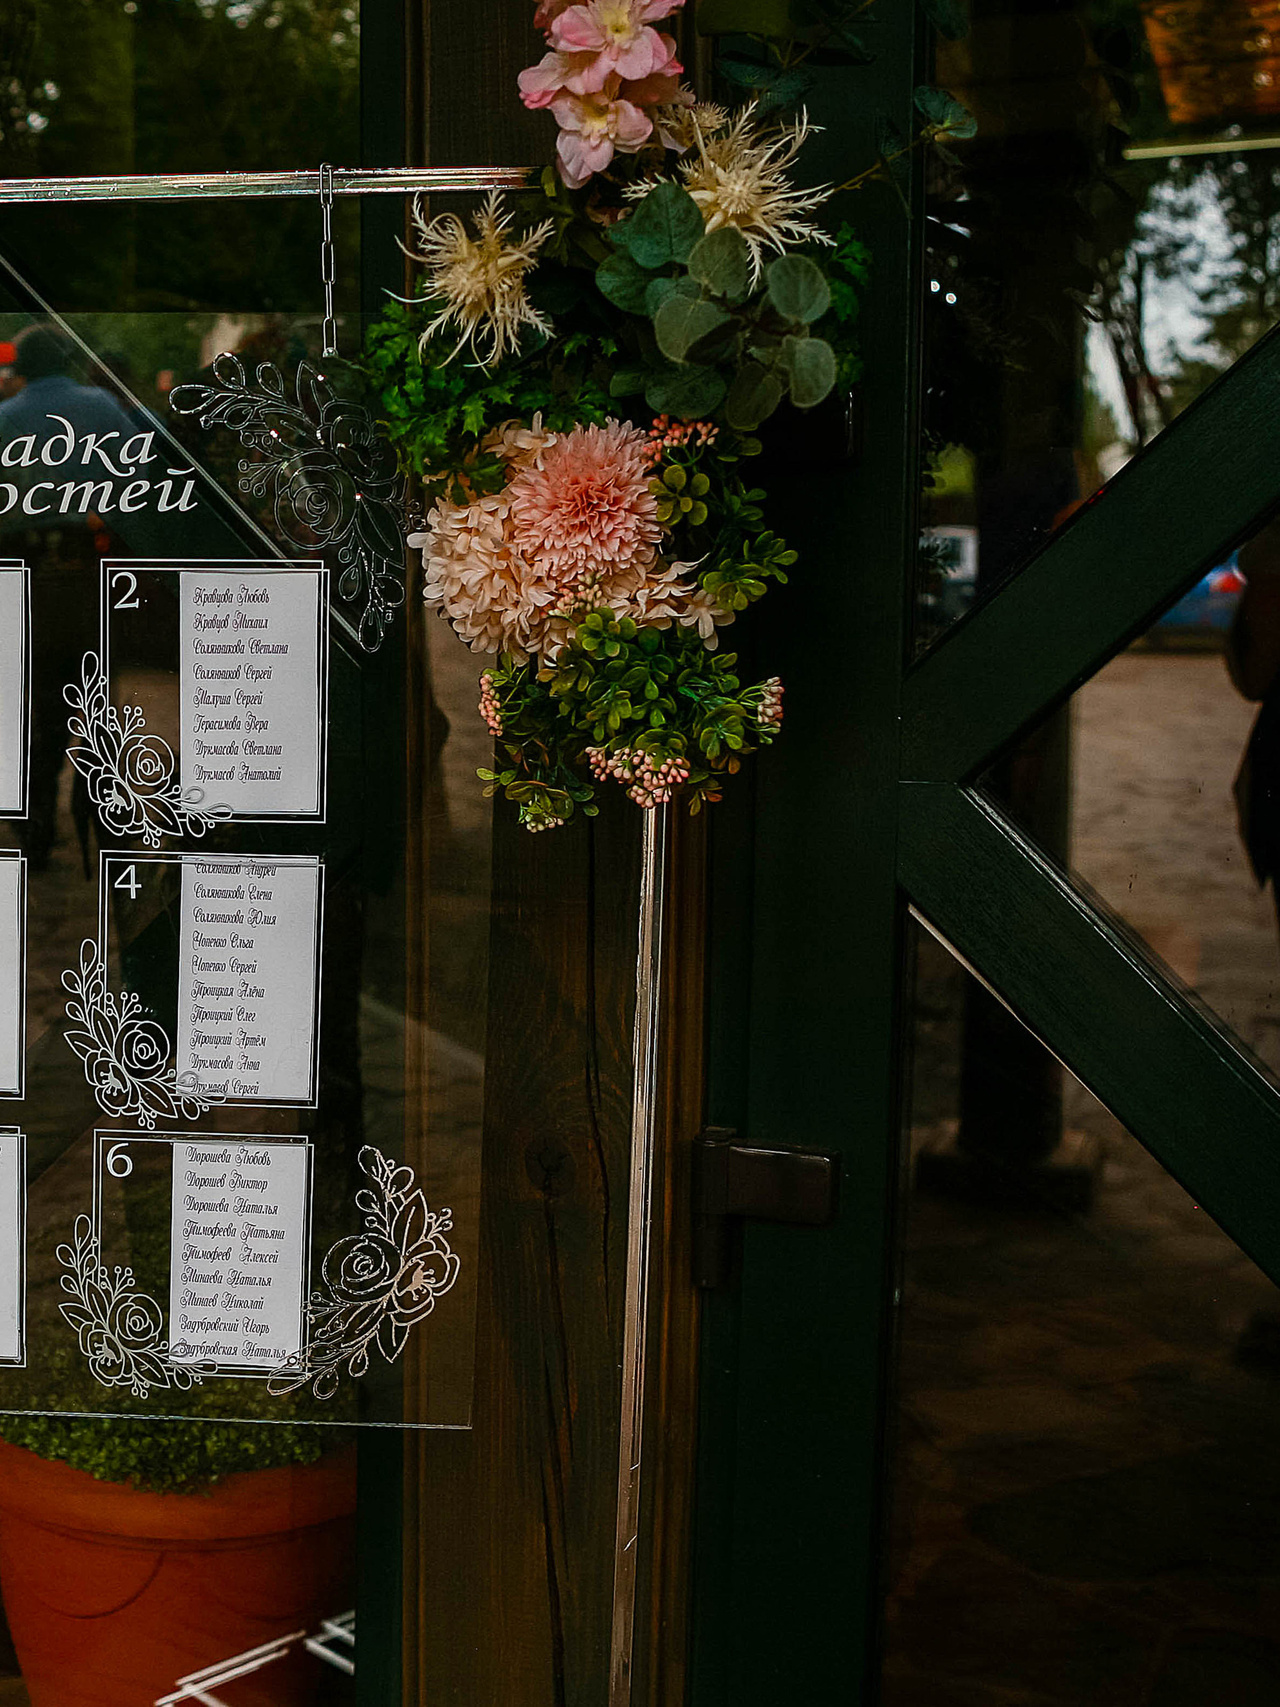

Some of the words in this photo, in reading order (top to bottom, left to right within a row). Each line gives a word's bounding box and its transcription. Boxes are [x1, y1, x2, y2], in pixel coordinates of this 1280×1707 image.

[111, 571, 140, 609] 2
[237, 584, 270, 606] Любовь
[232, 610, 268, 632] Михаил
[248, 638, 288, 654] Светлана
[244, 663, 272, 682] Сергей
[234, 688, 263, 708] Сергей
[193, 714, 241, 733] Герасимова
[245, 711, 268, 733] Вера
[242, 739, 282, 755] Светлана
[238, 761, 281, 784] Анатолий
[114, 864, 142, 899] 4
[248, 883, 272, 904] Елена
[247, 908, 276, 928] Юлия
[230, 932, 254, 948] Ольга
[229, 956, 257, 976] Сергей
[236, 1005, 256, 1021] Олег
[237, 1052, 260, 1073] Анна
[232, 1078, 259, 1096] Сергей
[106, 1142, 133, 1178] 6
[185, 1146, 231, 1165] Дорошева
[235, 1146, 271, 1166] Любовь
[185, 1171, 226, 1190] Дорошев
[229, 1169, 268, 1193] Виктор
[184, 1195, 229, 1214] Дорошева
[233, 1196, 278, 1216] Наталья
[183, 1219, 236, 1240] Тимофеева
[240, 1222, 285, 1241] Татьяна
[182, 1243, 232, 1264] Тимофеев
[239, 1241, 279, 1265] Алексей
[227, 1268, 272, 1288] Наталья
[221, 1292, 264, 1311] Николай
[242, 1317, 270, 1336] Игорь
[242, 1340, 286, 1360] Наталья
